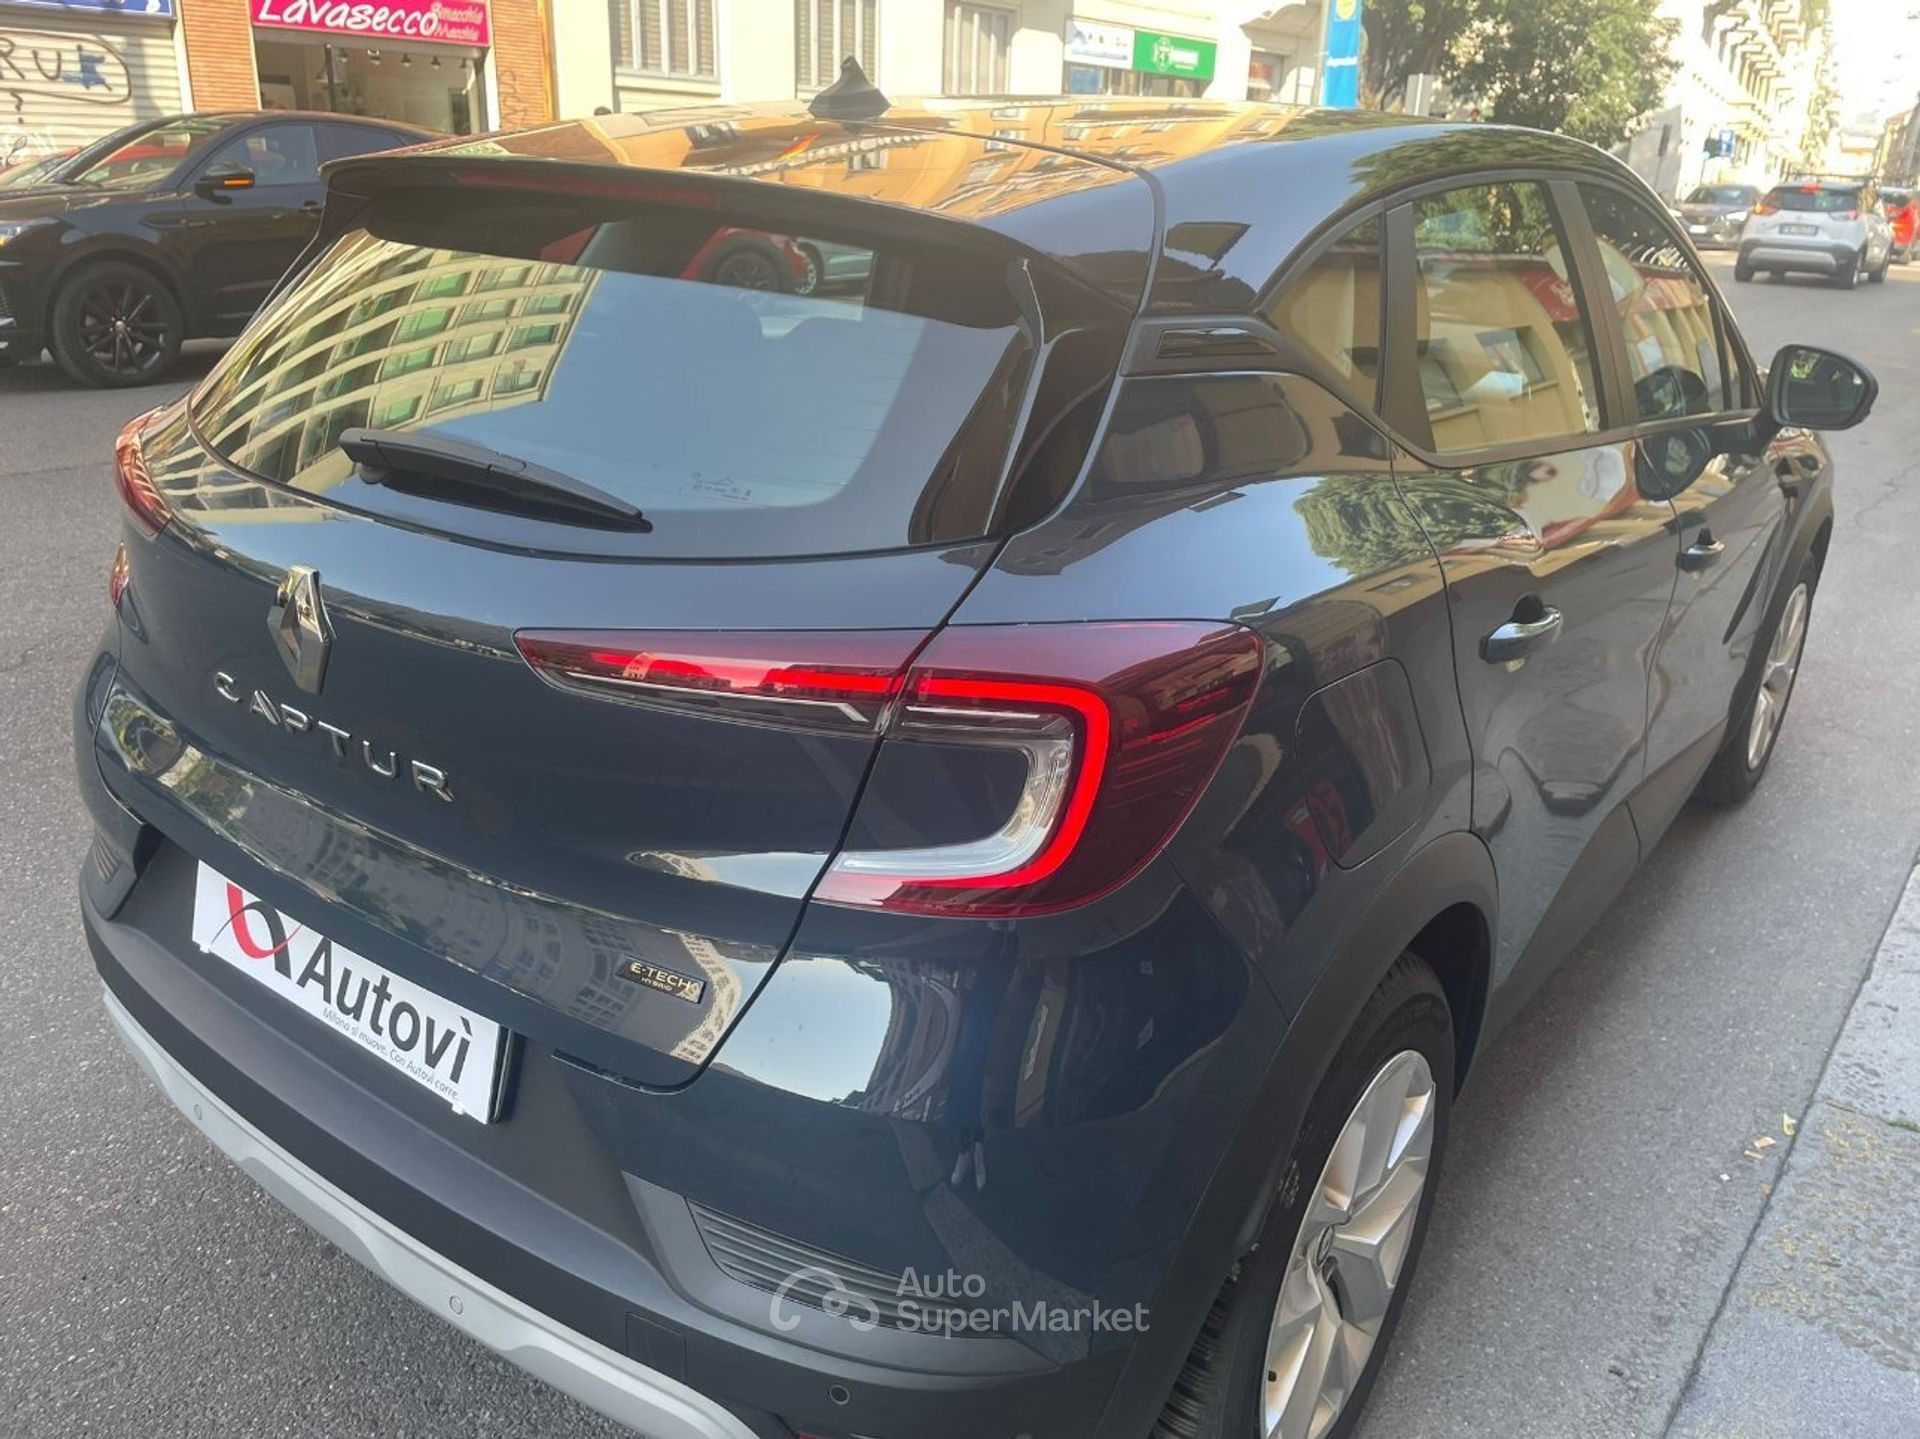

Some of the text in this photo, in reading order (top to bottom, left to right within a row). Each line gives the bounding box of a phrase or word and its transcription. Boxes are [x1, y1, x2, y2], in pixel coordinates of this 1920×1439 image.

[258, 0, 438, 36] Lavasecco
[213, 671, 456, 803] CAPTUR
[296, 934, 473, 1084] Autovì
